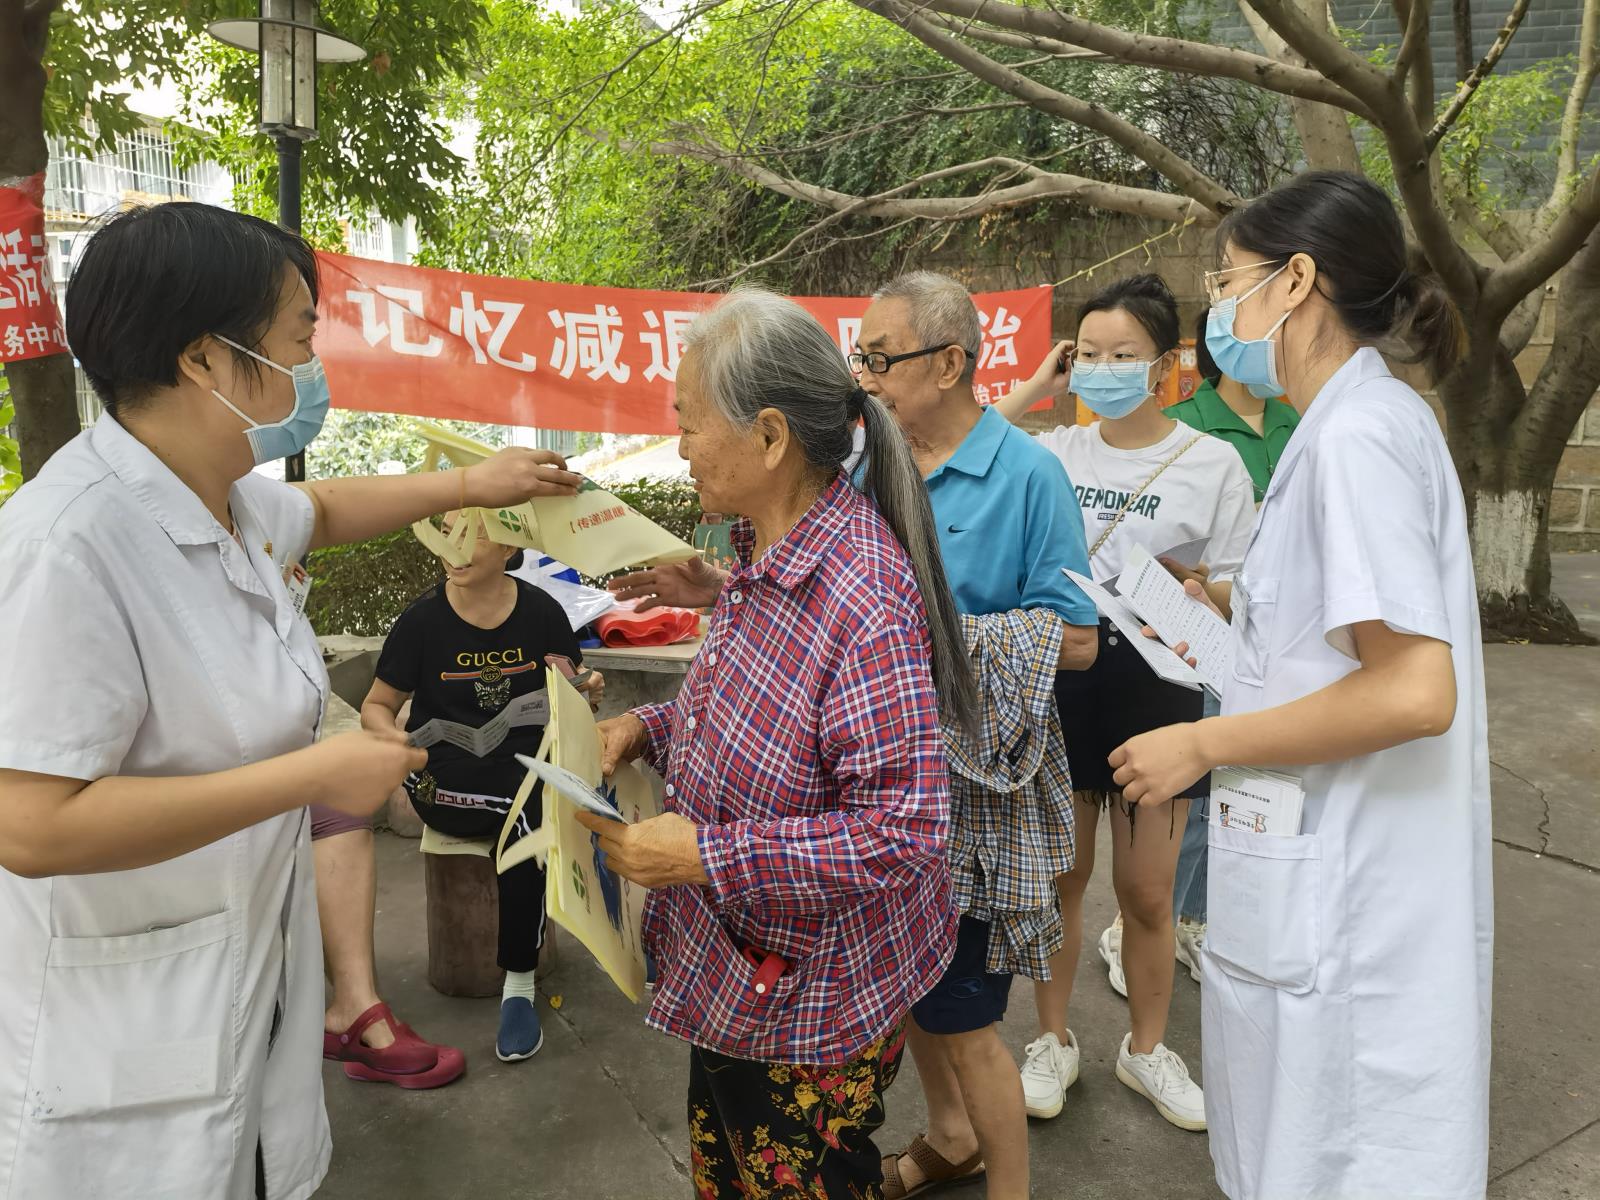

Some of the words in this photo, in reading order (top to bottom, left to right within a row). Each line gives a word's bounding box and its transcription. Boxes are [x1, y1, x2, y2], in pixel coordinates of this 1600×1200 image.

[0, 321, 67, 358] 务中心
[346, 284, 692, 384] 记忆减退
[456, 648, 524, 667] GUCCI
